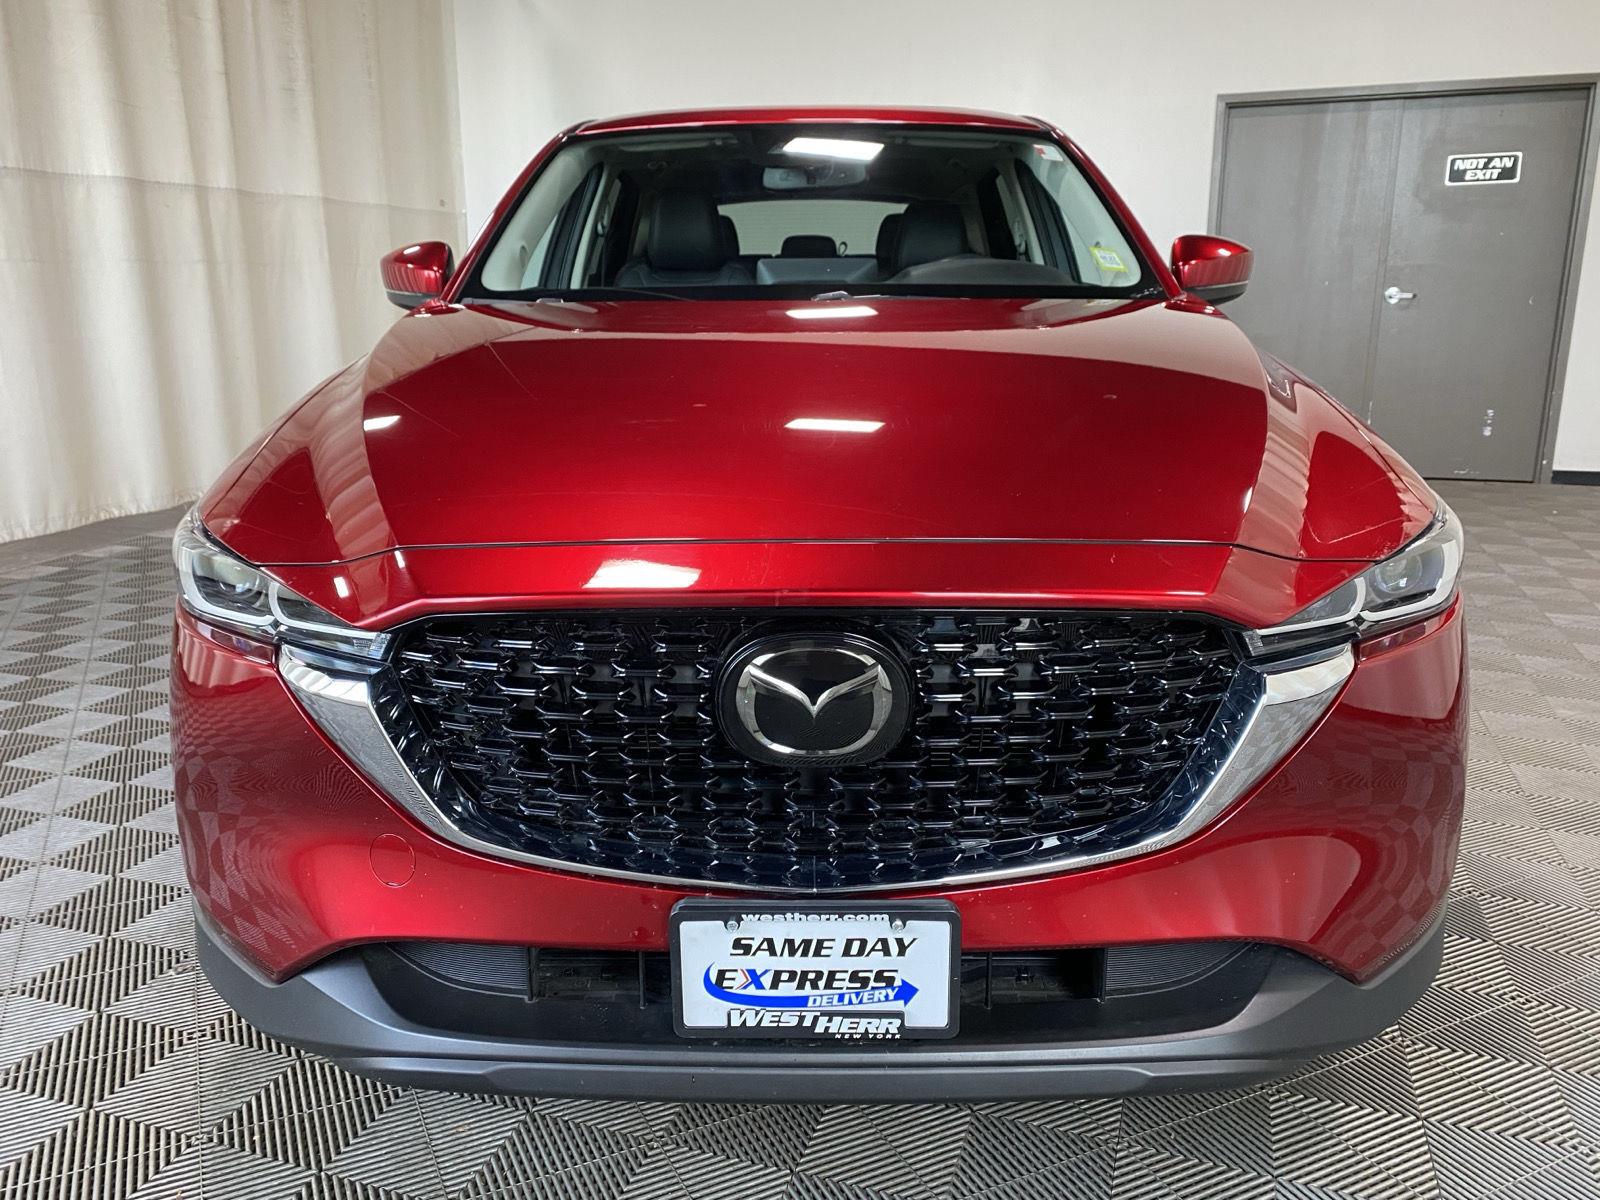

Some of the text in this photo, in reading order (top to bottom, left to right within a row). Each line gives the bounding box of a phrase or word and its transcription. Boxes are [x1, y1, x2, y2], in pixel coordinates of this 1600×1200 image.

[1454, 157, 1514, 170] NOT AN
[1464, 169, 1502, 180] EXIT
[730, 937, 918, 957] SAME DAY
[715, 969, 898, 990] EXPRESS
[807, 988, 899, 1007] DELIVERY
